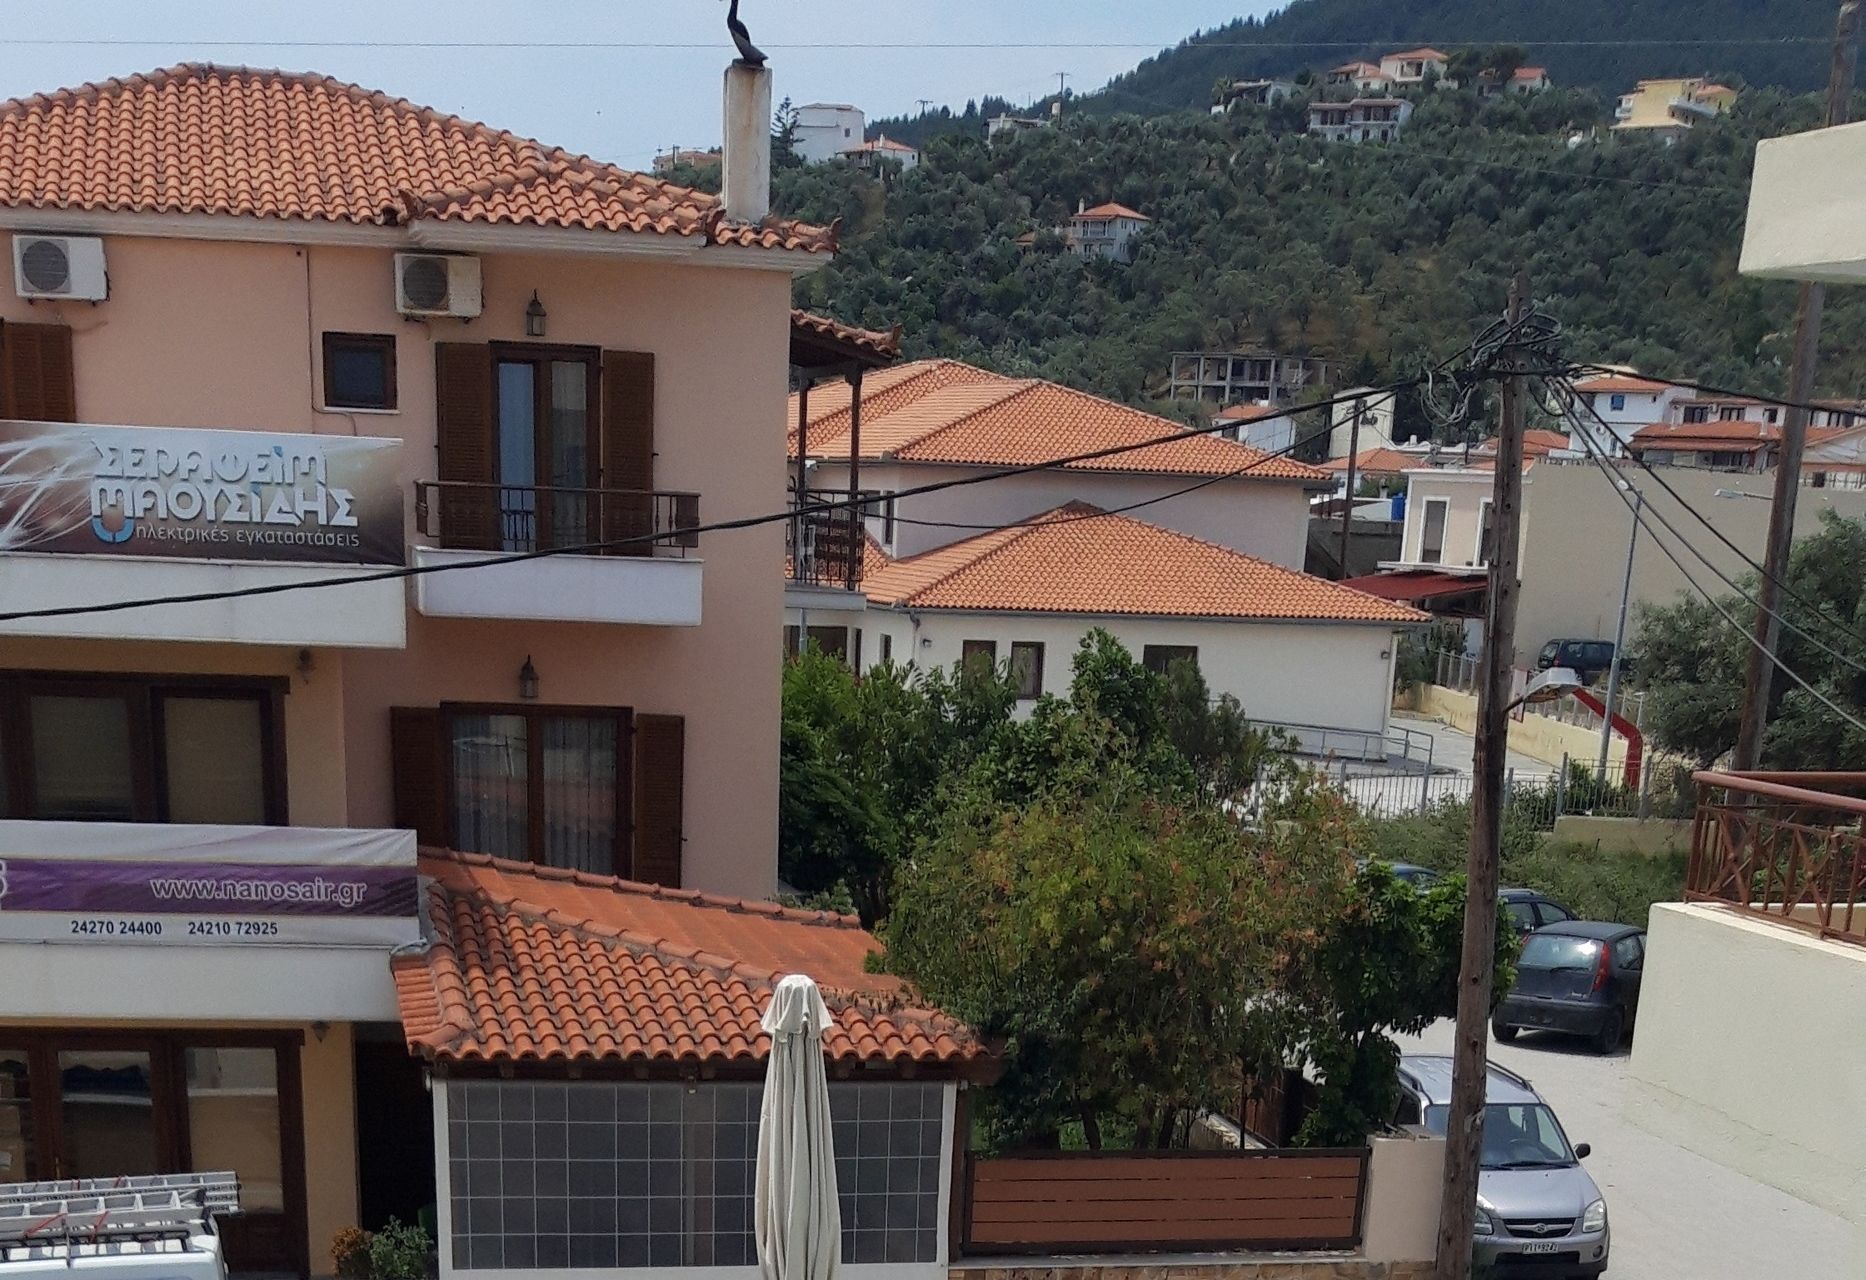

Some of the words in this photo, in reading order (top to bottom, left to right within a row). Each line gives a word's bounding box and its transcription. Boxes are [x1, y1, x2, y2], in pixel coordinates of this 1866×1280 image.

[135, 525, 229, 544] ηλεκτρικές
[236, 528, 360, 547] εγκαταστάσεις
[150, 877, 367, 907] www.nanosair.gr
[71, 920, 115, 935] 24270
[119, 920, 163, 936] 24400
[187, 921, 231, 936] 24210
[235, 922, 279, 936] 72925
